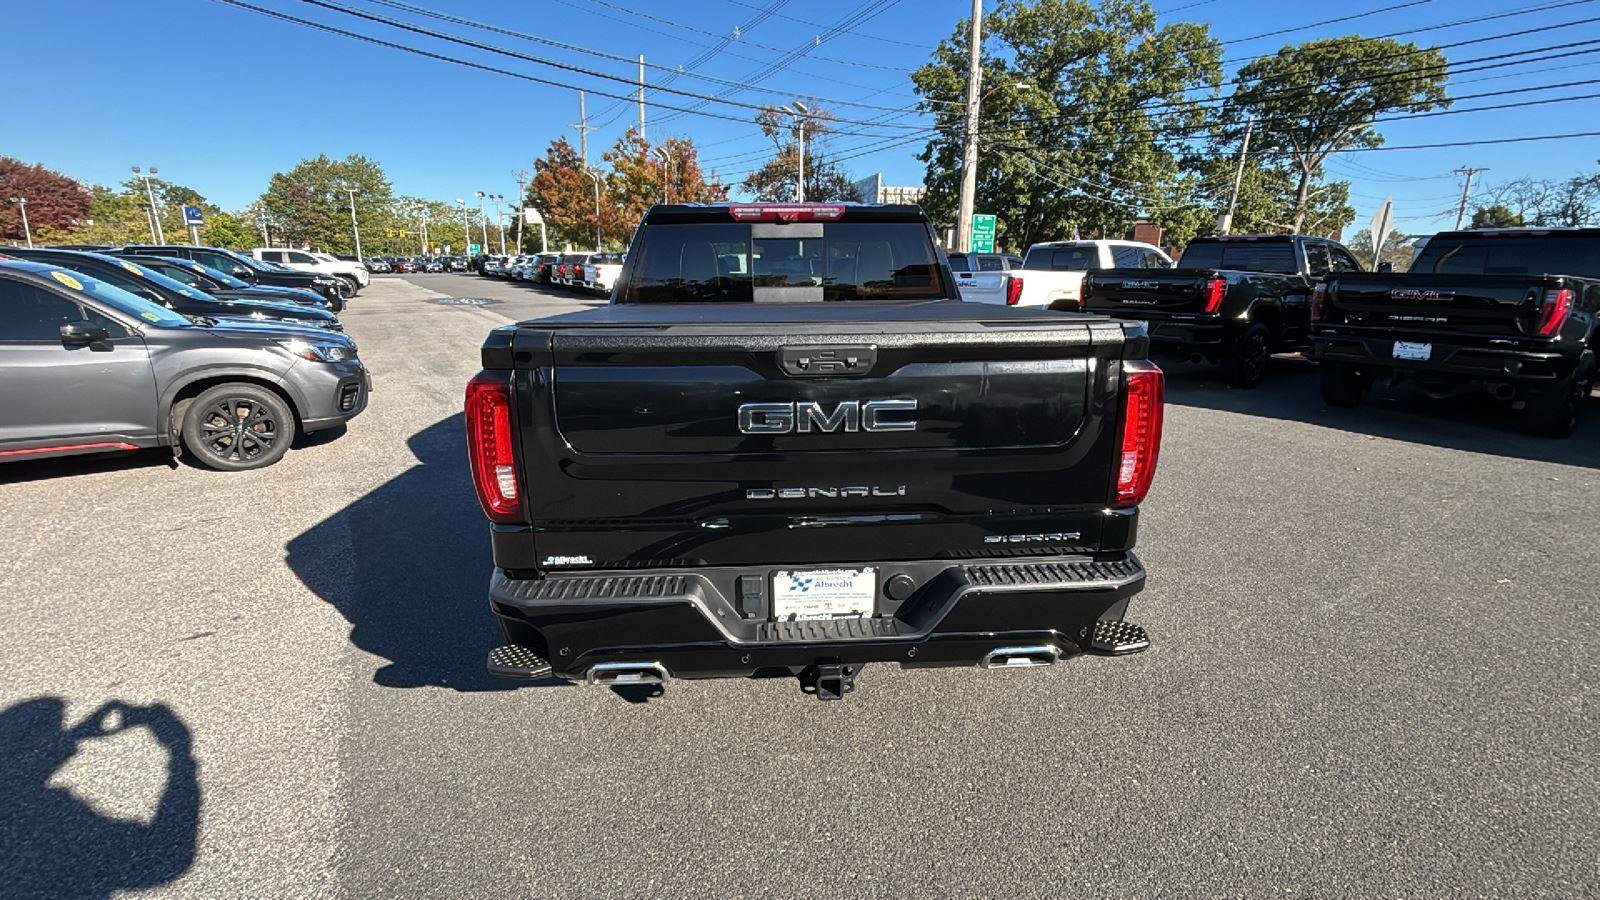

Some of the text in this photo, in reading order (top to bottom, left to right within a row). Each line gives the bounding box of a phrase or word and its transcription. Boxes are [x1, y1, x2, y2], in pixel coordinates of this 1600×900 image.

[738, 399, 918, 435] GMC
[746, 485, 906, 500] DENALI
[984, 532, 1081, 543] SIERRA
[814, 579, 853, 588] Albrecht
